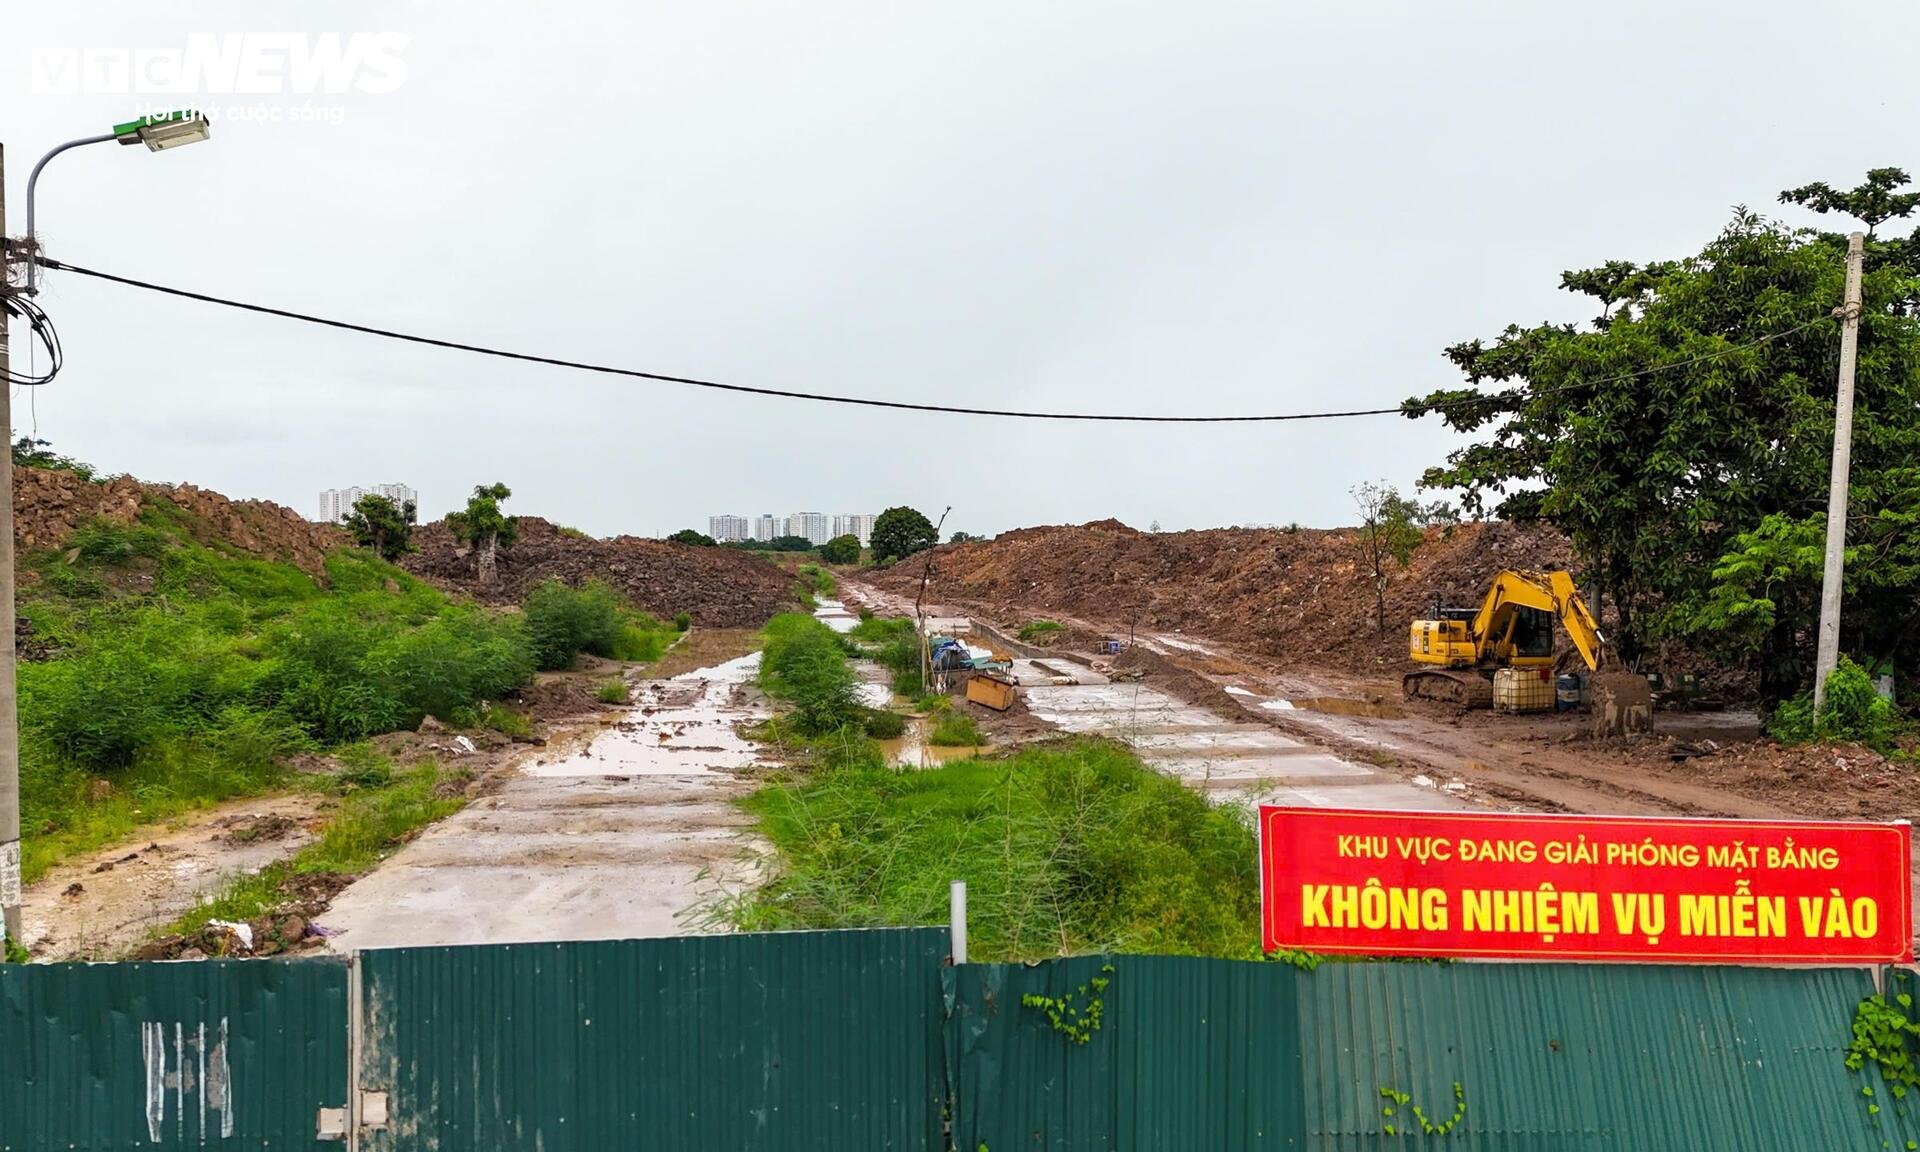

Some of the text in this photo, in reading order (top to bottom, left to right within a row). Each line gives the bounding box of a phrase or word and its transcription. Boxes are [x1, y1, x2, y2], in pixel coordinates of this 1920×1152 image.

[1338, 834, 1840, 873] KHU VỰC ĐANG GIẢI PHÓNG MẶT BẰNG
[1301, 877, 1879, 945] KHÔNG NHIỆM VỤ MIỄN VÀO
